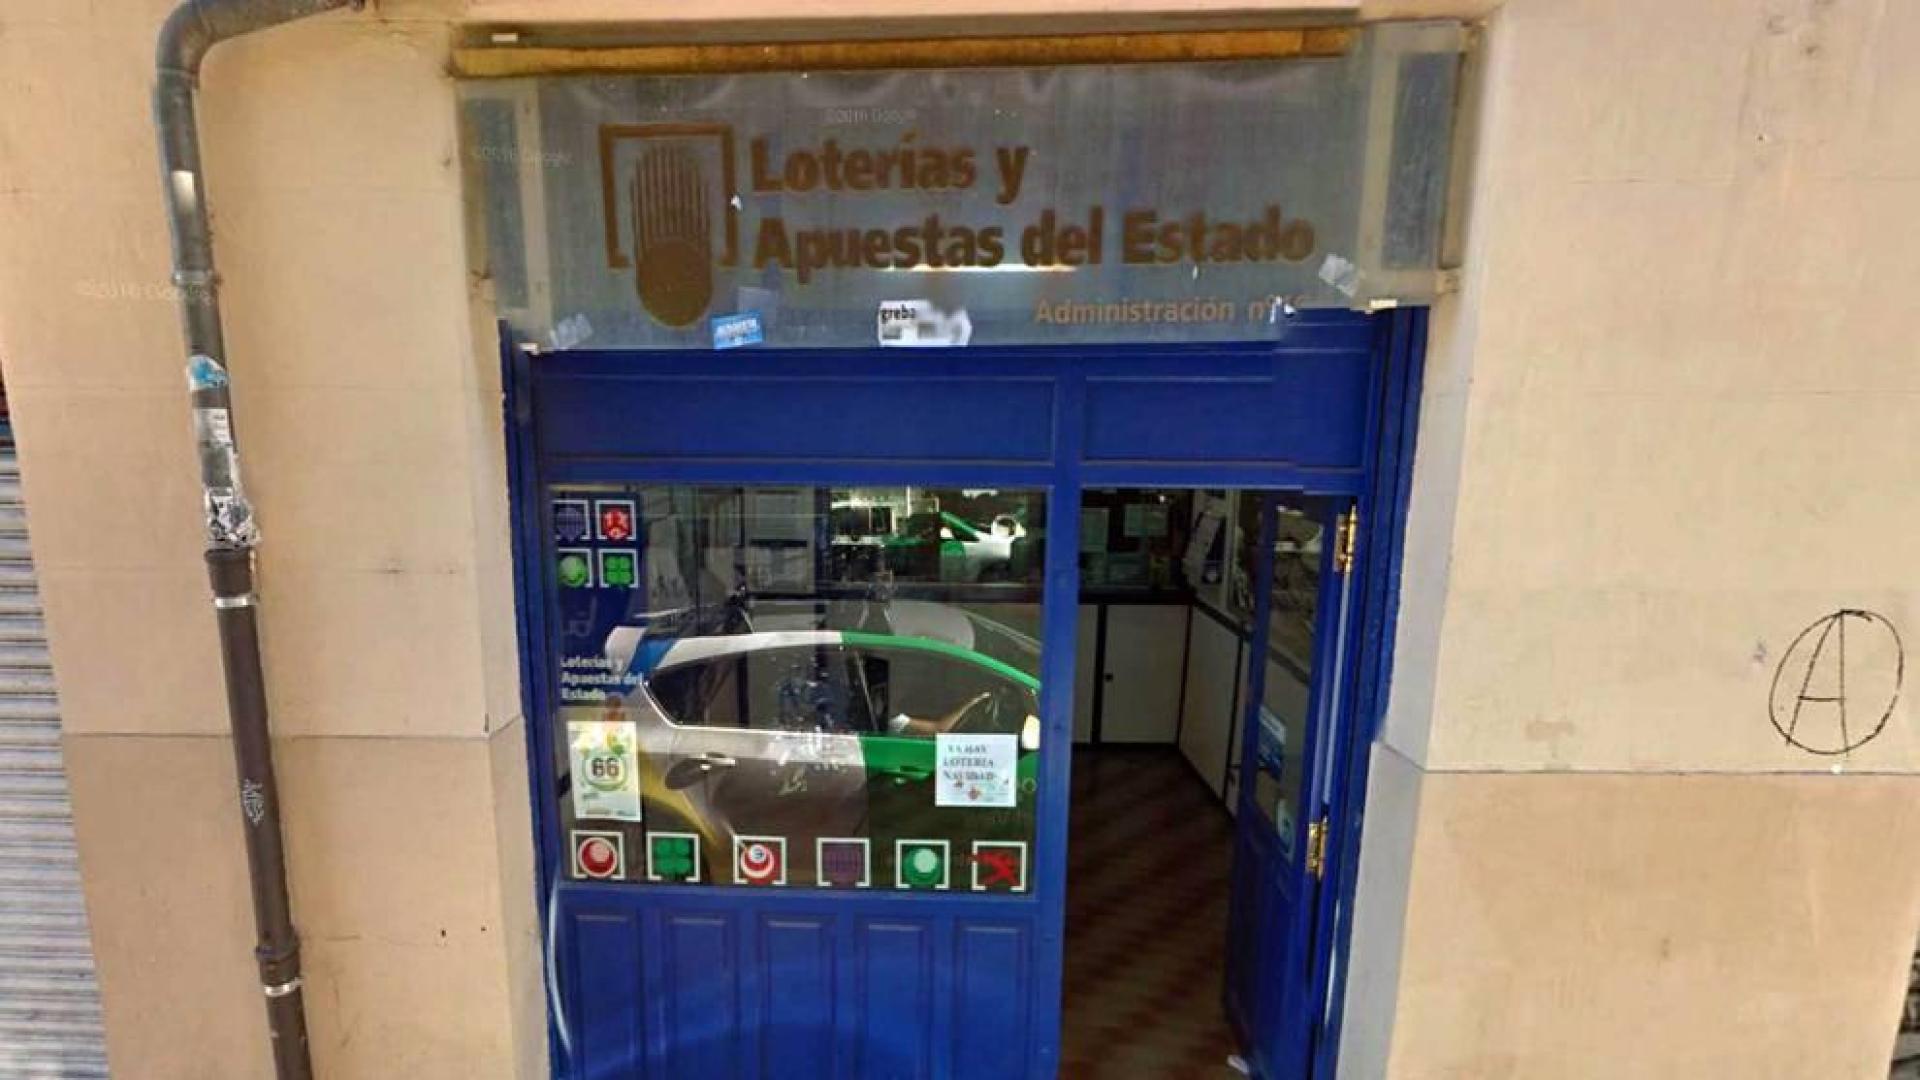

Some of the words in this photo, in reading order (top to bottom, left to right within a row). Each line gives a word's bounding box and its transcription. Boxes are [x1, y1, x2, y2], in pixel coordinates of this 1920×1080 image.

[751, 134, 975, 191] Loterías
[996, 145, 1030, 204] y
[754, 215, 1004, 282] Apuestas
[1021, 205, 1102, 267] del
[1121, 203, 1315, 265] Estado
[1035, 299, 1233, 325] Administración
[591, 756, 619, 778] 66
